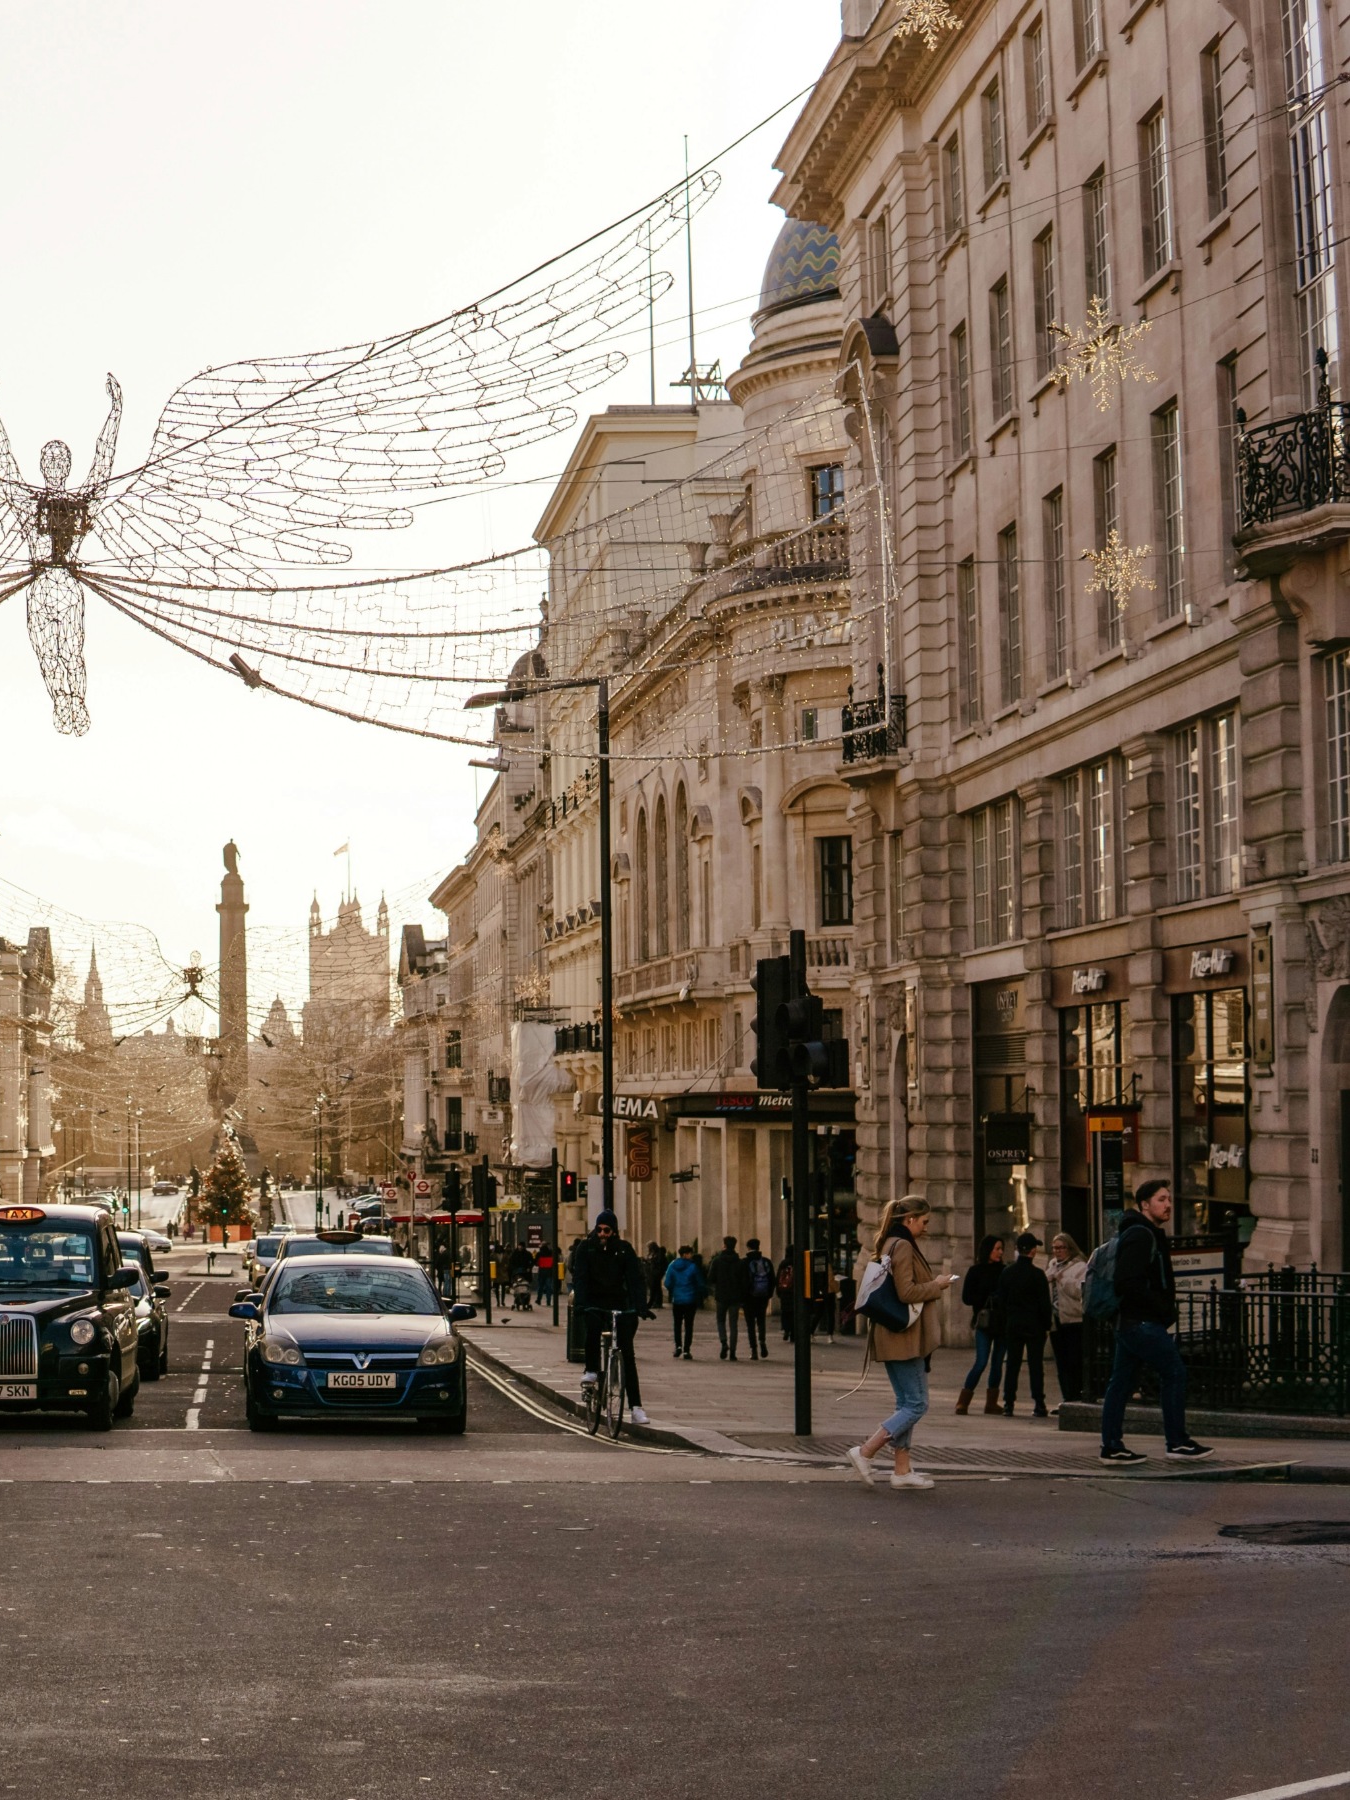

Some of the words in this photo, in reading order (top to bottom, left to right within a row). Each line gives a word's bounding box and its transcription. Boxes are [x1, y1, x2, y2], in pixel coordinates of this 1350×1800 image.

[598, 1095, 659, 1119] CNEMA
[987, 1149, 1027, 1158] OSPREY
[3, 1209, 34, 1219] TAXI
[333, 1375, 365, 1387] KG05
[367, 1375, 391, 1387] UDY
[6, 1385, 30, 1398] SKN
